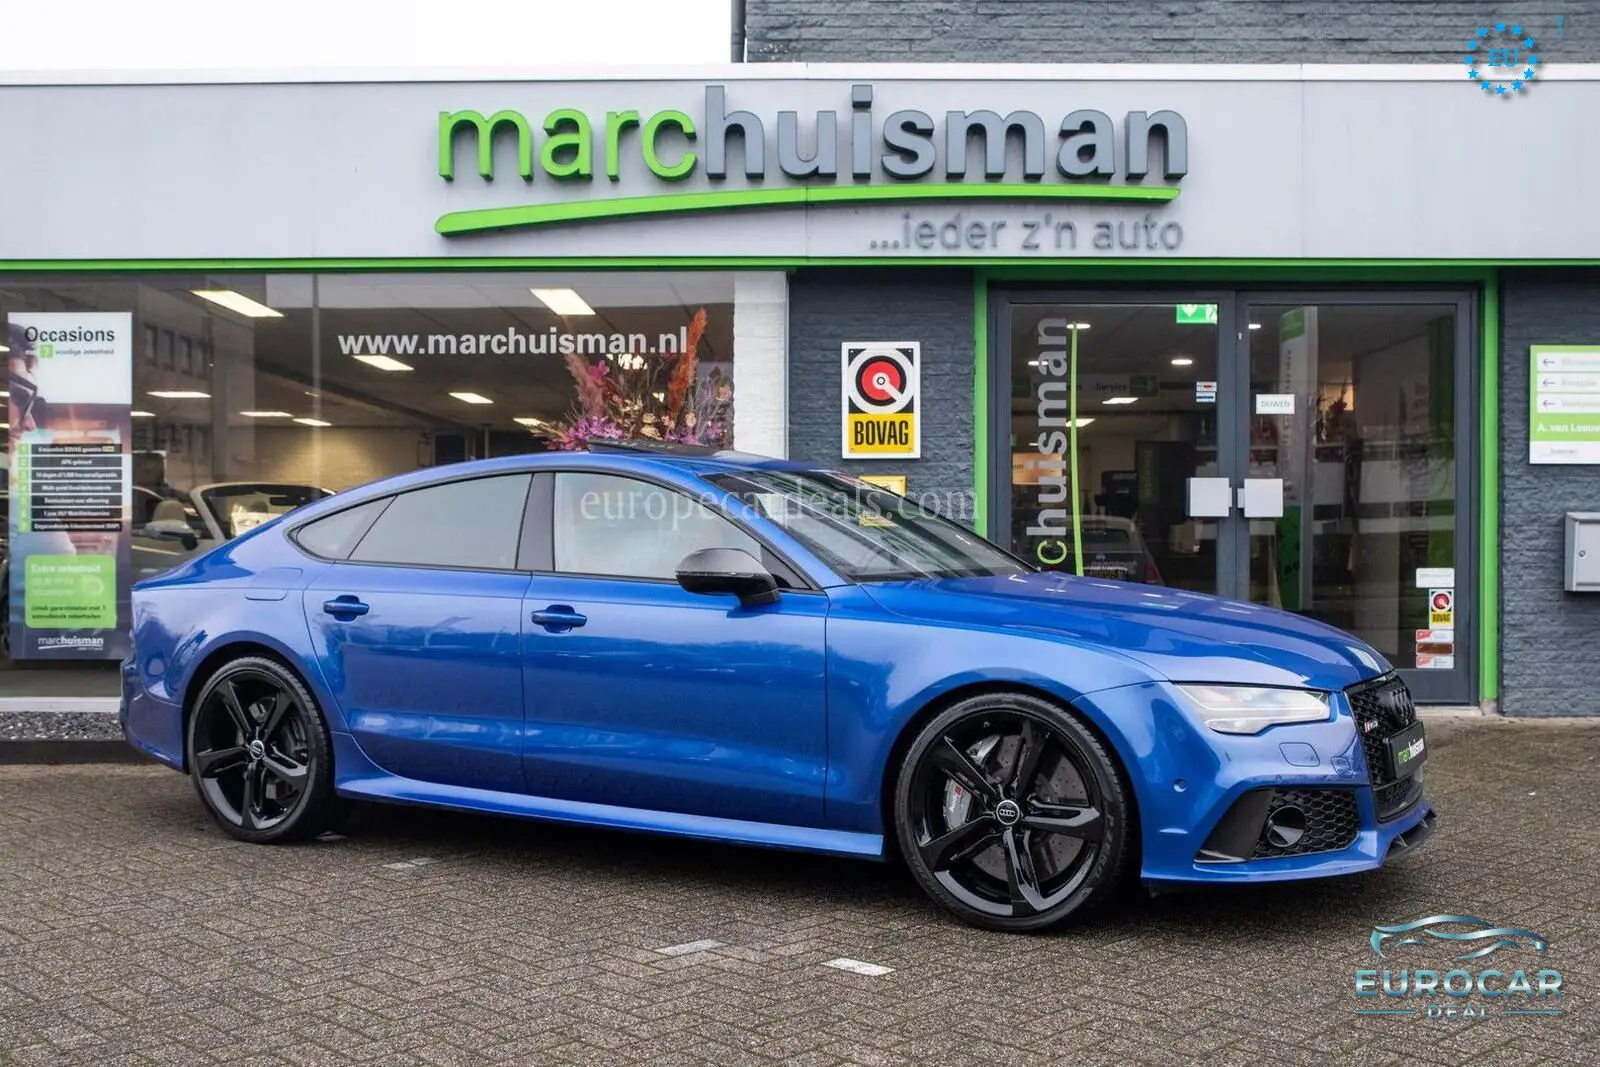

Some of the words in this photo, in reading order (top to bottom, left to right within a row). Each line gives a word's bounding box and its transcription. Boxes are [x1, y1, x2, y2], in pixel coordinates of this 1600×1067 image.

[438, 85, 1188, 182] marchuisman
[1021, 213, 1077, 250] z'n
[1093, 214, 1184, 251] auto
[25, 326, 115, 342] Occasions
[338, 327, 687, 355] www.marchuisman.nl
[854, 420, 909, 446] BOVAG
[1432, 613, 1451, 623] BOVAG
[38, 635, 104, 645] marchuisman
